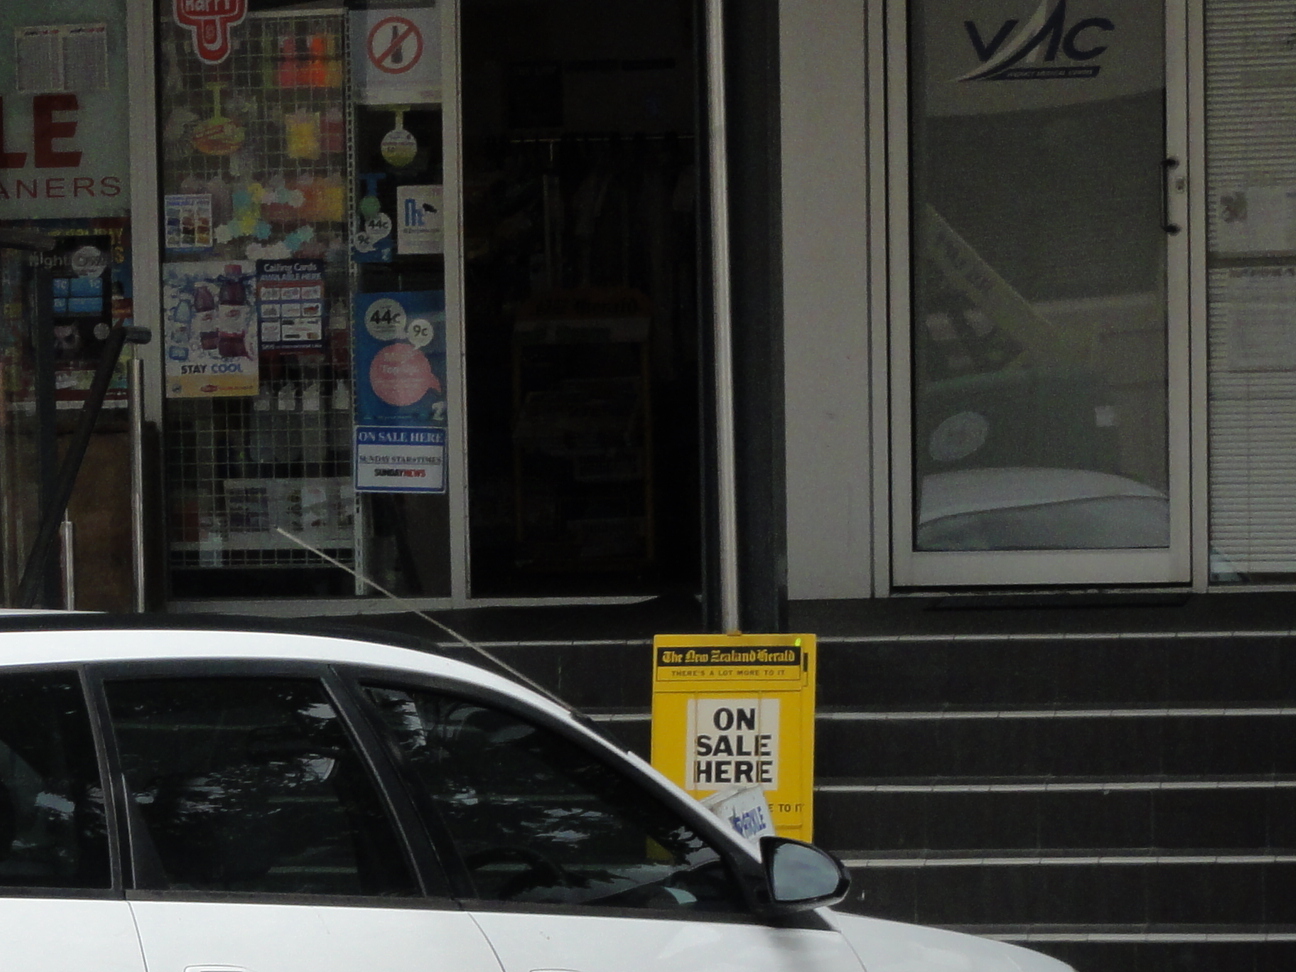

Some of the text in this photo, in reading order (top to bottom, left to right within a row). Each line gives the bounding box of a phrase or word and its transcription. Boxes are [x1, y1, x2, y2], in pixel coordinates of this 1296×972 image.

[370, 310, 401, 325] 44c
[413, 324, 428, 337] 9c
[181, 363, 243, 375] STAY COOL
[358, 431, 444, 443] ON SALE HERE
[662, 649, 796, 663] The New Zealand Herald
[713, 708, 756, 731] ON
[697, 735, 772, 757] SALE
[695, 760, 773, 784] HERE
[779, 804, 792, 813] TO
